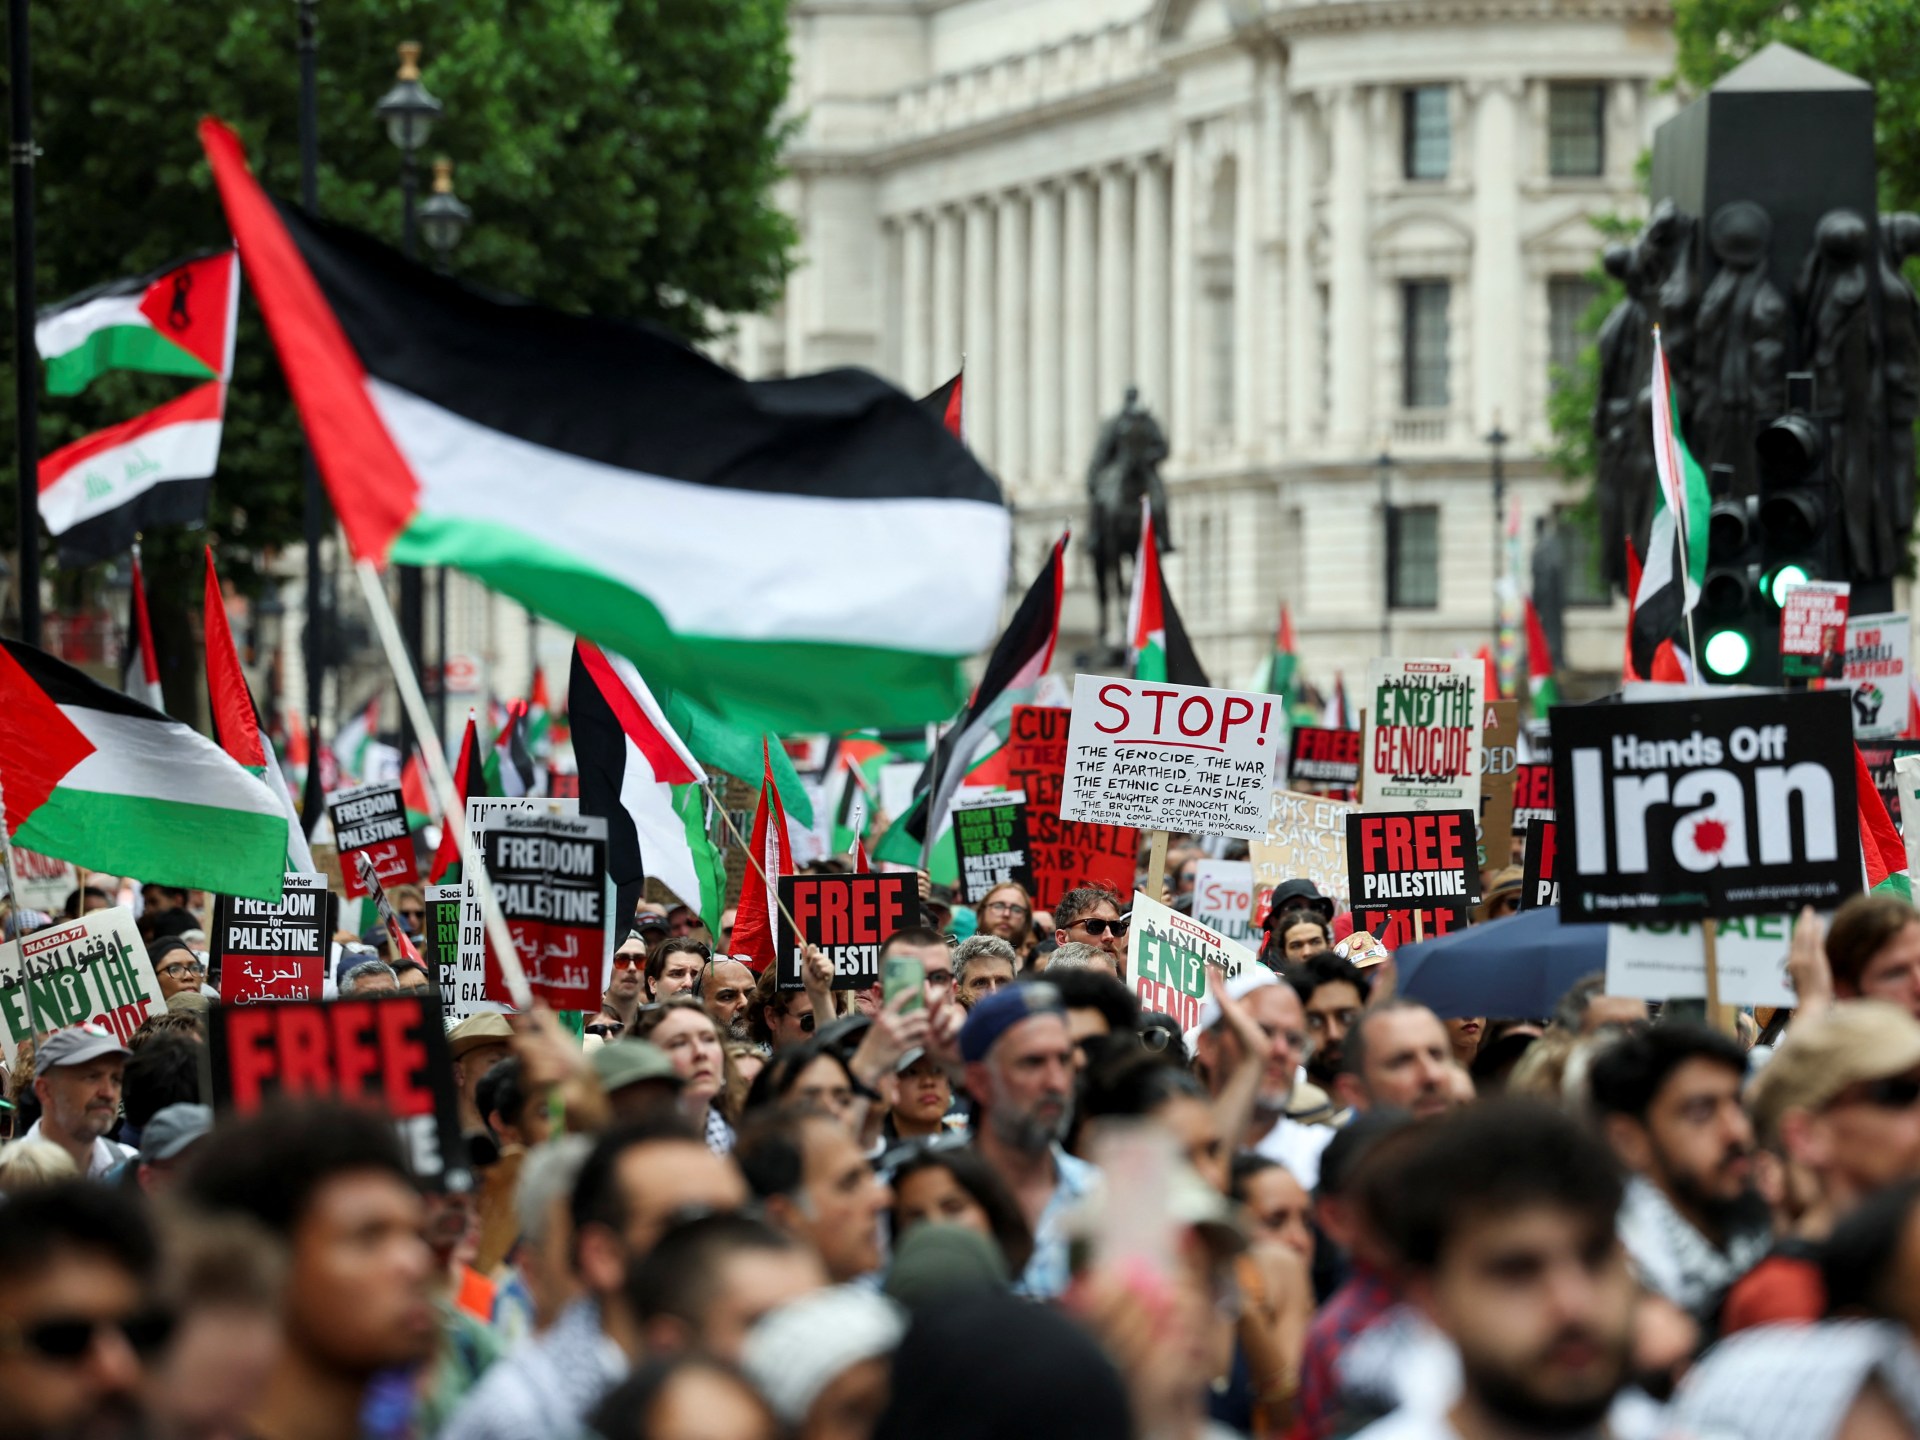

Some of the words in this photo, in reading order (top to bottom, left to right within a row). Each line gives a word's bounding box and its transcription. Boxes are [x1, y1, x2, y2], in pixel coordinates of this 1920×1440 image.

[1094, 684, 1272, 746] STOP!
[1376, 686, 1436, 728] END
[1441, 687, 1476, 728] THE
[1017, 708, 1072, 741] CUT
[1078, 746, 1107, 757] THE
[1115, 748, 1199, 769] GENOCIDE,
[1203, 756, 1232, 769] THE
[1236, 761, 1267, 778] WAR,
[1296, 728, 1360, 764] FREE
[1374, 725, 1474, 777] GENOCIDE
[1612, 731, 1724, 770] Hands
[1729, 724, 1788, 763] Off
[1076, 761, 1106, 772] THE
[1112, 763, 1191, 782] APARTHEID,
[1197, 772, 1222, 784] THE
[1226, 775, 1264, 790] LIES,
[1293, 760, 1358, 780] PALESTINE
[1073, 776, 1102, 787] THE
[1108, 778, 1160, 791] ETHNIC
[1165, 783, 1252, 805] CLEANSING,
[1073, 790, 1098, 799] THE
[1102, 791, 1159, 805] SLAUGHTER
[1162, 798, 1175, 806] OF
[1179, 798, 1229, 812] INNOCENT
[335, 792, 398, 825] FREEDOM
[1070, 808, 1087, 816] THE
[1091, 810, 1121, 818] MEDIA
[1126, 813, 1183, 826] COMPLICITY,
[1208, 822, 1266, 835] HYPOCRISY...
[1081, 800, 1102, 809] THE
[1109, 802, 1152, 813] BRUTAL
[1162, 808, 1231, 823] OCCUPATION,
[1571, 748, 1838, 876] Iran
[337, 816, 407, 852] PALESTINE
[996, 821, 1013, 837] TO
[1361, 815, 1464, 873] FREE
[964, 850, 1025, 872] PALESTINE
[1363, 870, 1467, 899] PALESTINE
[269, 915, 283, 927] for
[794, 879, 903, 946] FREE
[25, 934, 69, 955] NAKBA
[68, 928, 83, 943] 77
[228, 927, 319, 951] PALESTINE
[1173, 917, 1208, 940] NAKBA
[1208, 934, 1220, 945] 77
[242, 960, 302, 984] الحرية
[794, 945, 879, 977] PESTI
[1137, 929, 1205, 999] END
[0, 965, 92, 1045] END
[89, 944, 151, 1014] THE
[234, 984, 310, 1006] لفلسطين
[226, 1000, 437, 1121] FREE
